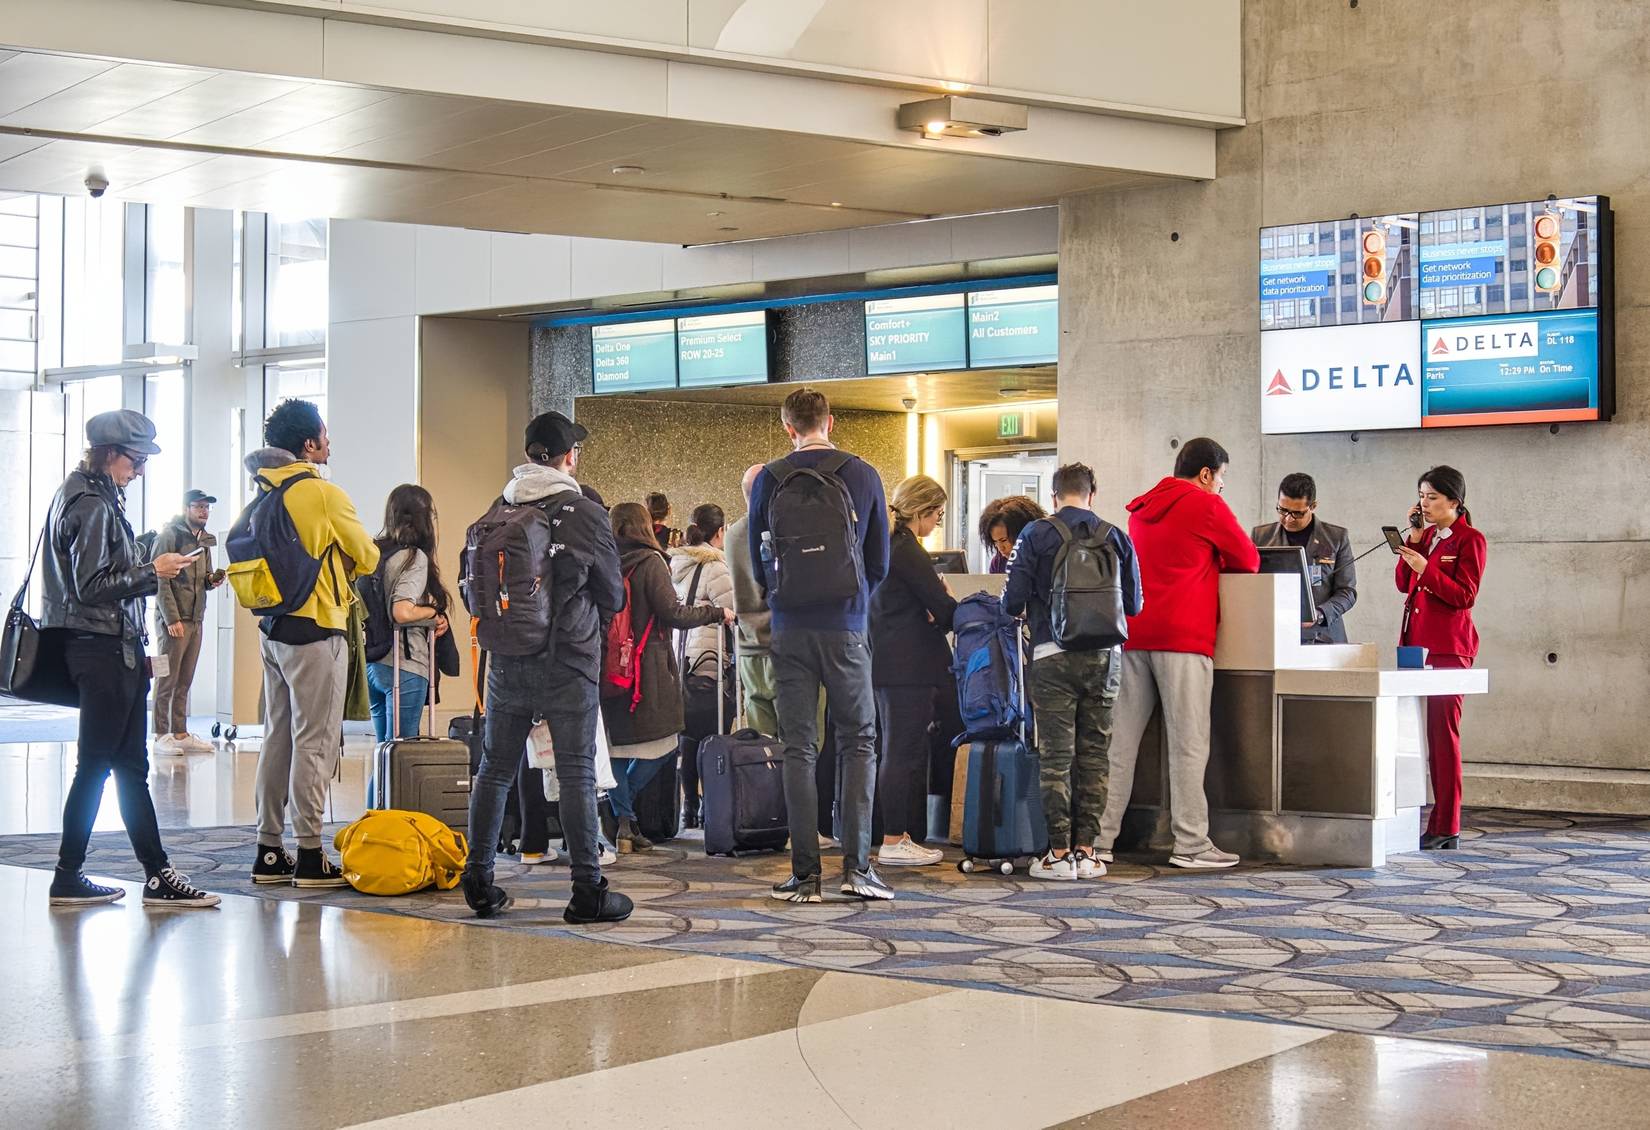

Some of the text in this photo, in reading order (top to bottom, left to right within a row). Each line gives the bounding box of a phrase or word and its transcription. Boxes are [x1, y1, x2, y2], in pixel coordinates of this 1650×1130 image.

[1422, 261, 1471, 273] Get network
[1263, 274, 1306, 286] Get network
[1422, 270, 1492, 284] data prioritization
[1263, 284, 1325, 296] data prioritization
[972, 311, 1000, 322] Main2
[869, 319, 912, 331] Comfort+
[972, 325, 1039, 339] All Customers
[680, 333, 742, 345] Premium Select
[869, 331, 930, 346] SKY PRIORITY
[1456, 331, 1533, 351] DELTA
[1546, 335, 1575, 345] DL 118
[595, 342, 631, 353] Delta One
[681, 347, 724, 360] ROW 20-25
[596, 355, 630, 368] Delta 360
[870, 350, 896, 361] Main1
[1500, 365, 1536, 376] 12:29 PM
[1540, 363, 1574, 374] On Time
[596, 370, 630, 381] Diamond
[1302, 363, 1414, 391] DELTA
[1426, 371, 1445, 380] Paris
[1001, 415, 1018, 436] EXIT
